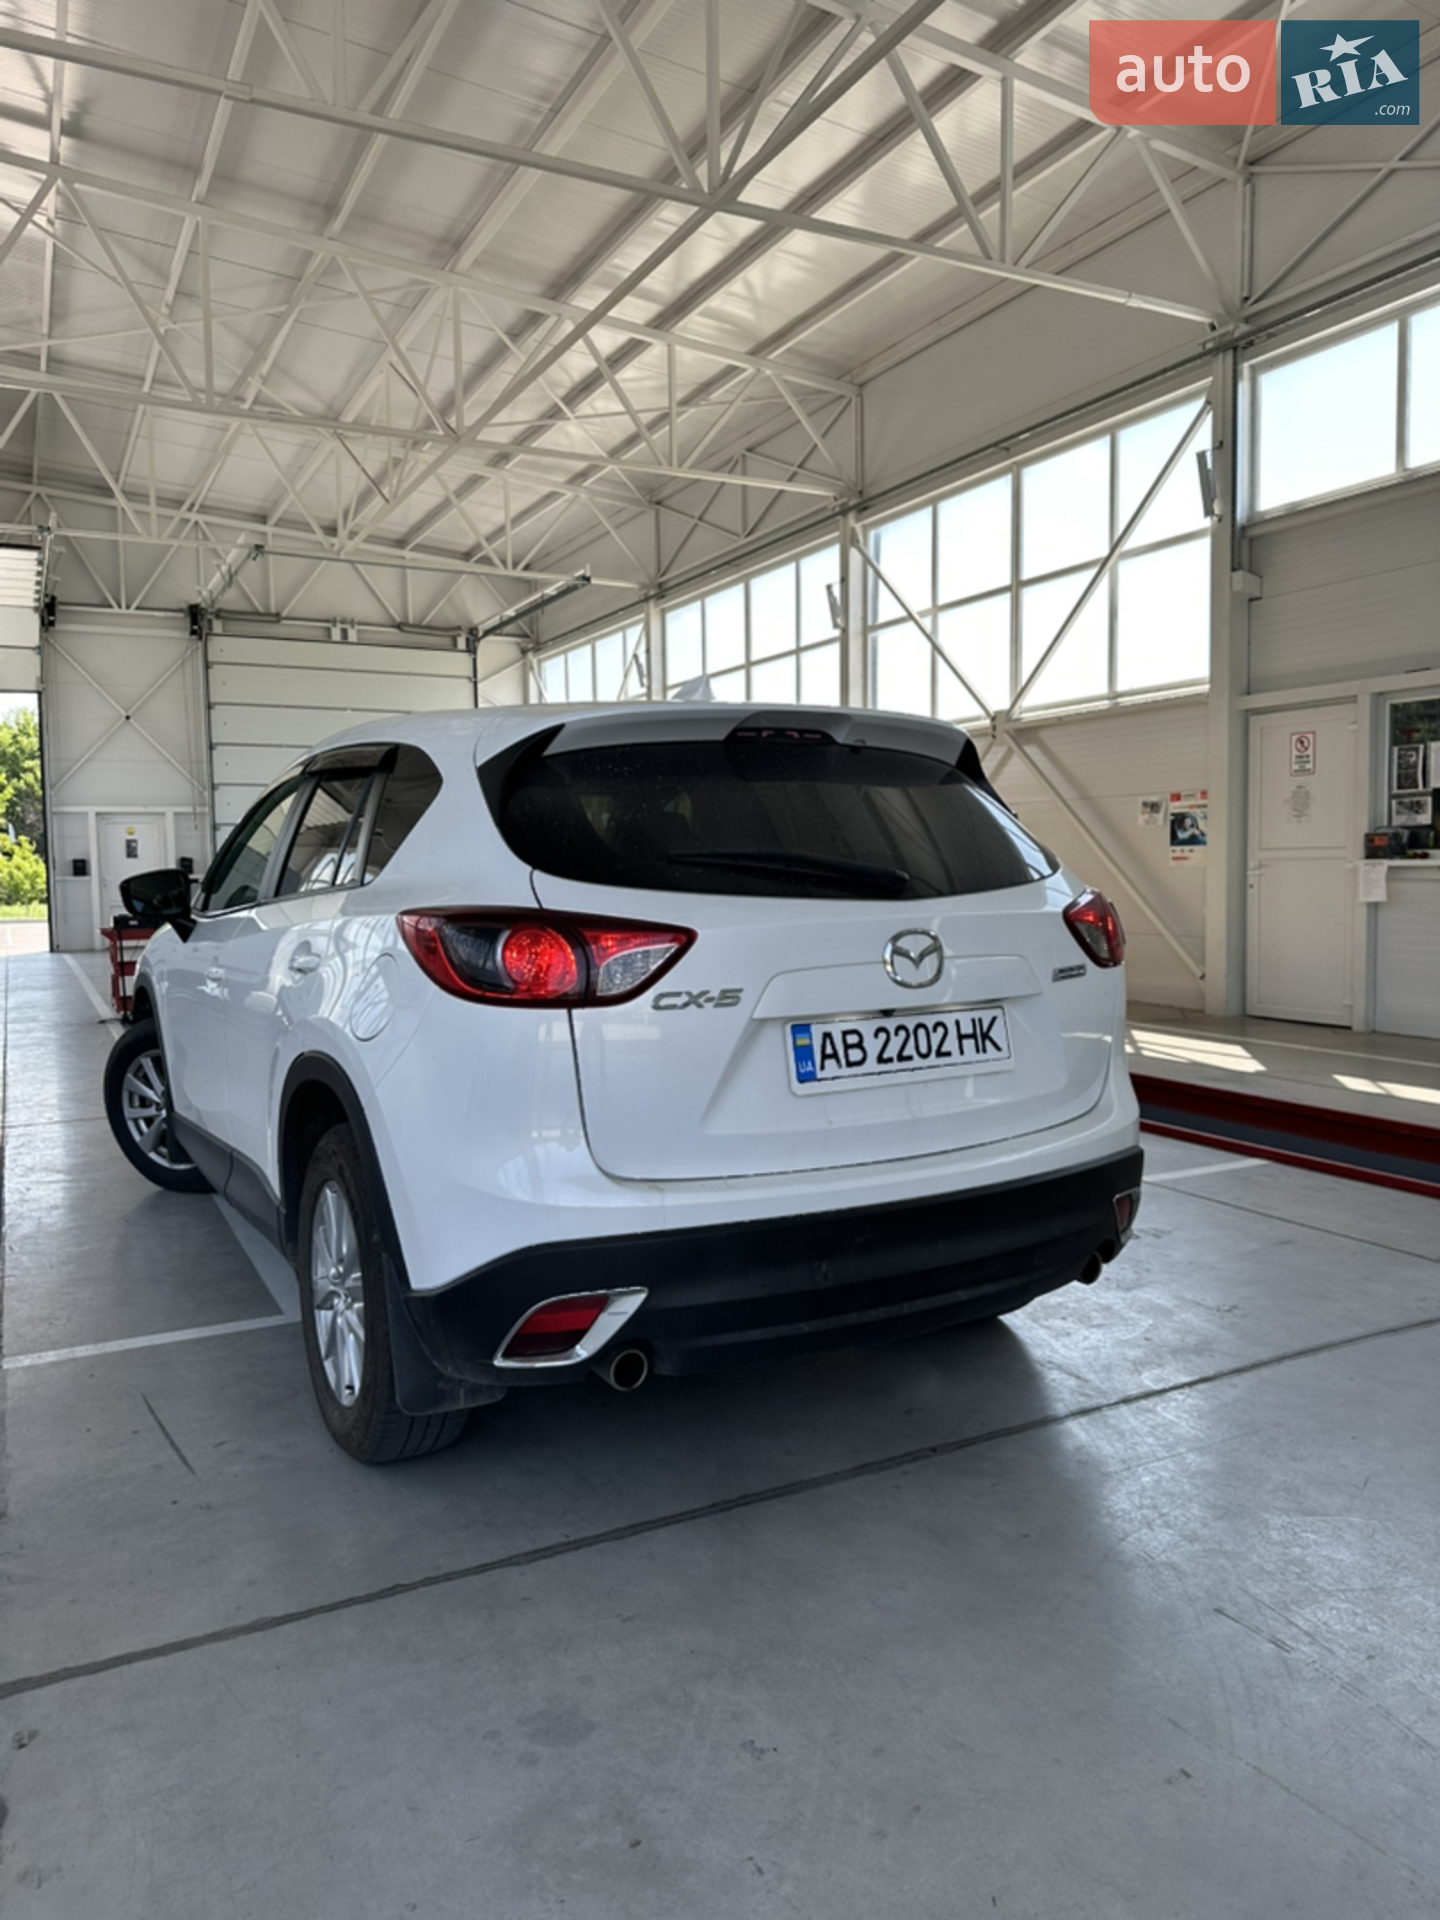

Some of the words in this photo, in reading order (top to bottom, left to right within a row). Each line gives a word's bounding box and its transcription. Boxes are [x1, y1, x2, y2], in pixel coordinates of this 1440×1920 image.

[651, 987, 744, 1011] CX-5
[819, 1028, 868, 1072] AB
[873, 1021, 952, 1065] 2202
[954, 1015, 1003, 1056] HK
[799, 1060, 815, 1073] UA
